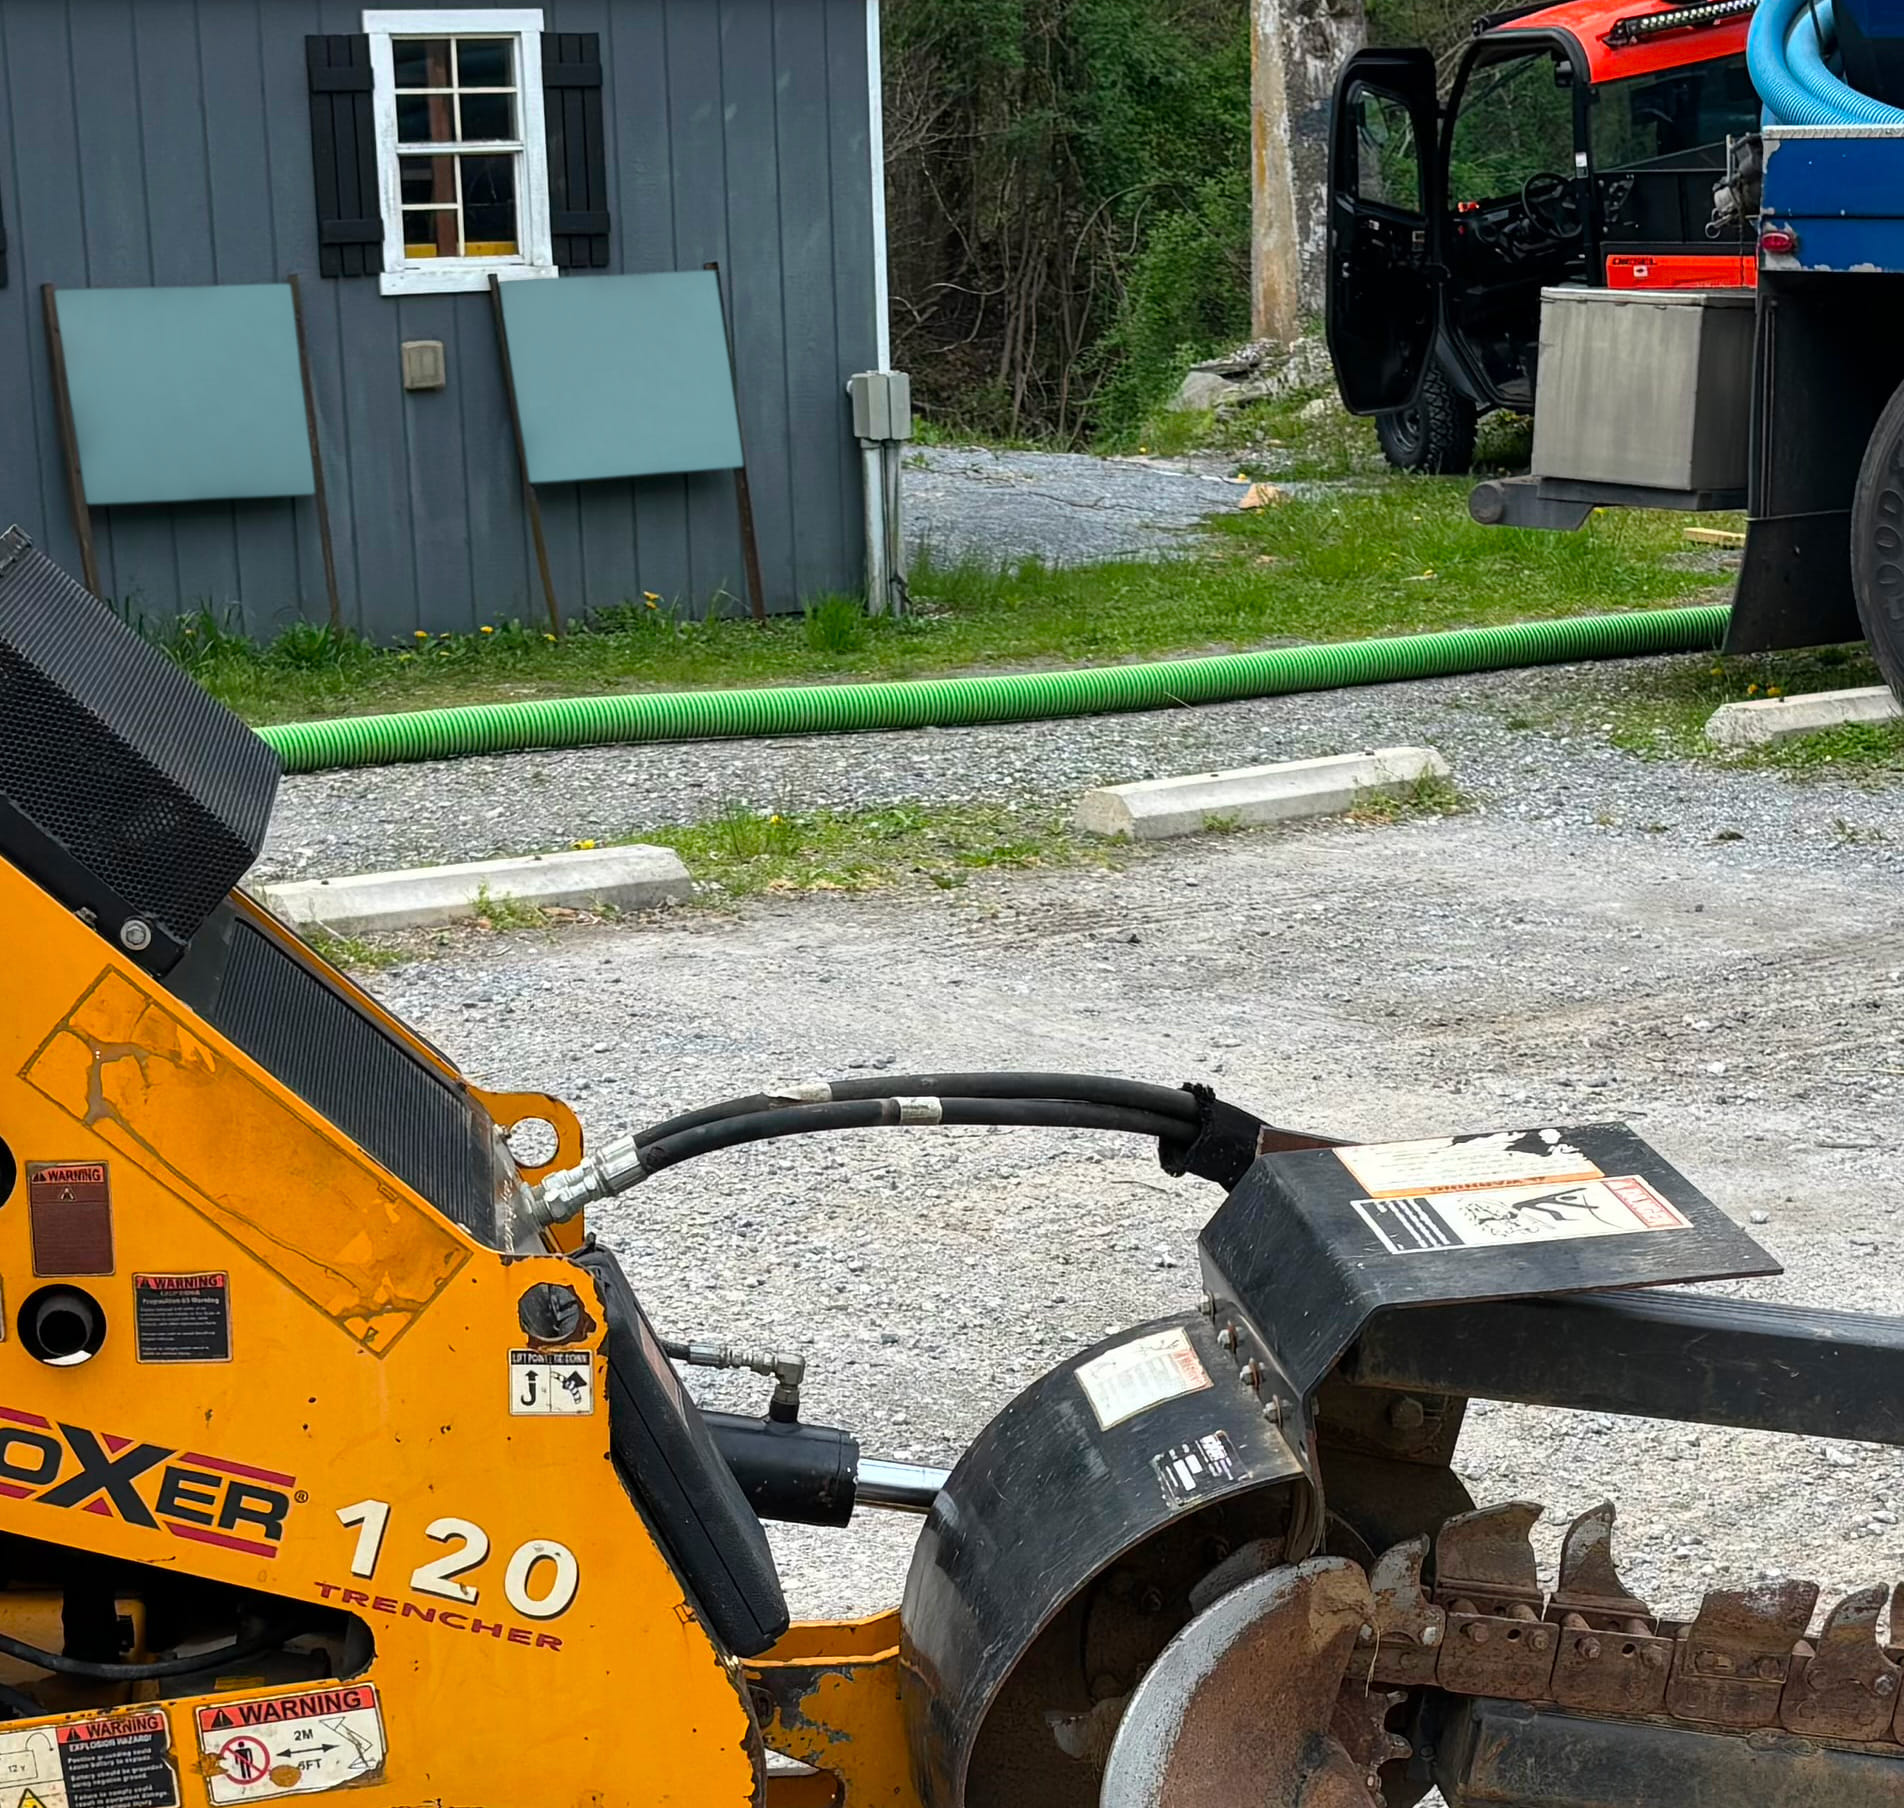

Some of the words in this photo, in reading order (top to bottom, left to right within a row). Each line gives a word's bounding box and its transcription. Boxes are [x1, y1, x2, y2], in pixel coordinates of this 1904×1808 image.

[48, 1169, 101, 1181] WARNING
[335, 1498, 579, 1619] 120
[313, 1580, 564, 1653] TRENCHER
[239, 1691, 361, 1724] WARNING
[86, 1716, 159, 1739] WARNING
[294, 1729, 314, 1741] 2M
[69, 1739, 116, 1753] EXPLOSION
[118, 1734, 153, 1746] HAZARD!
[8, 1764, 18, 1773] 12
